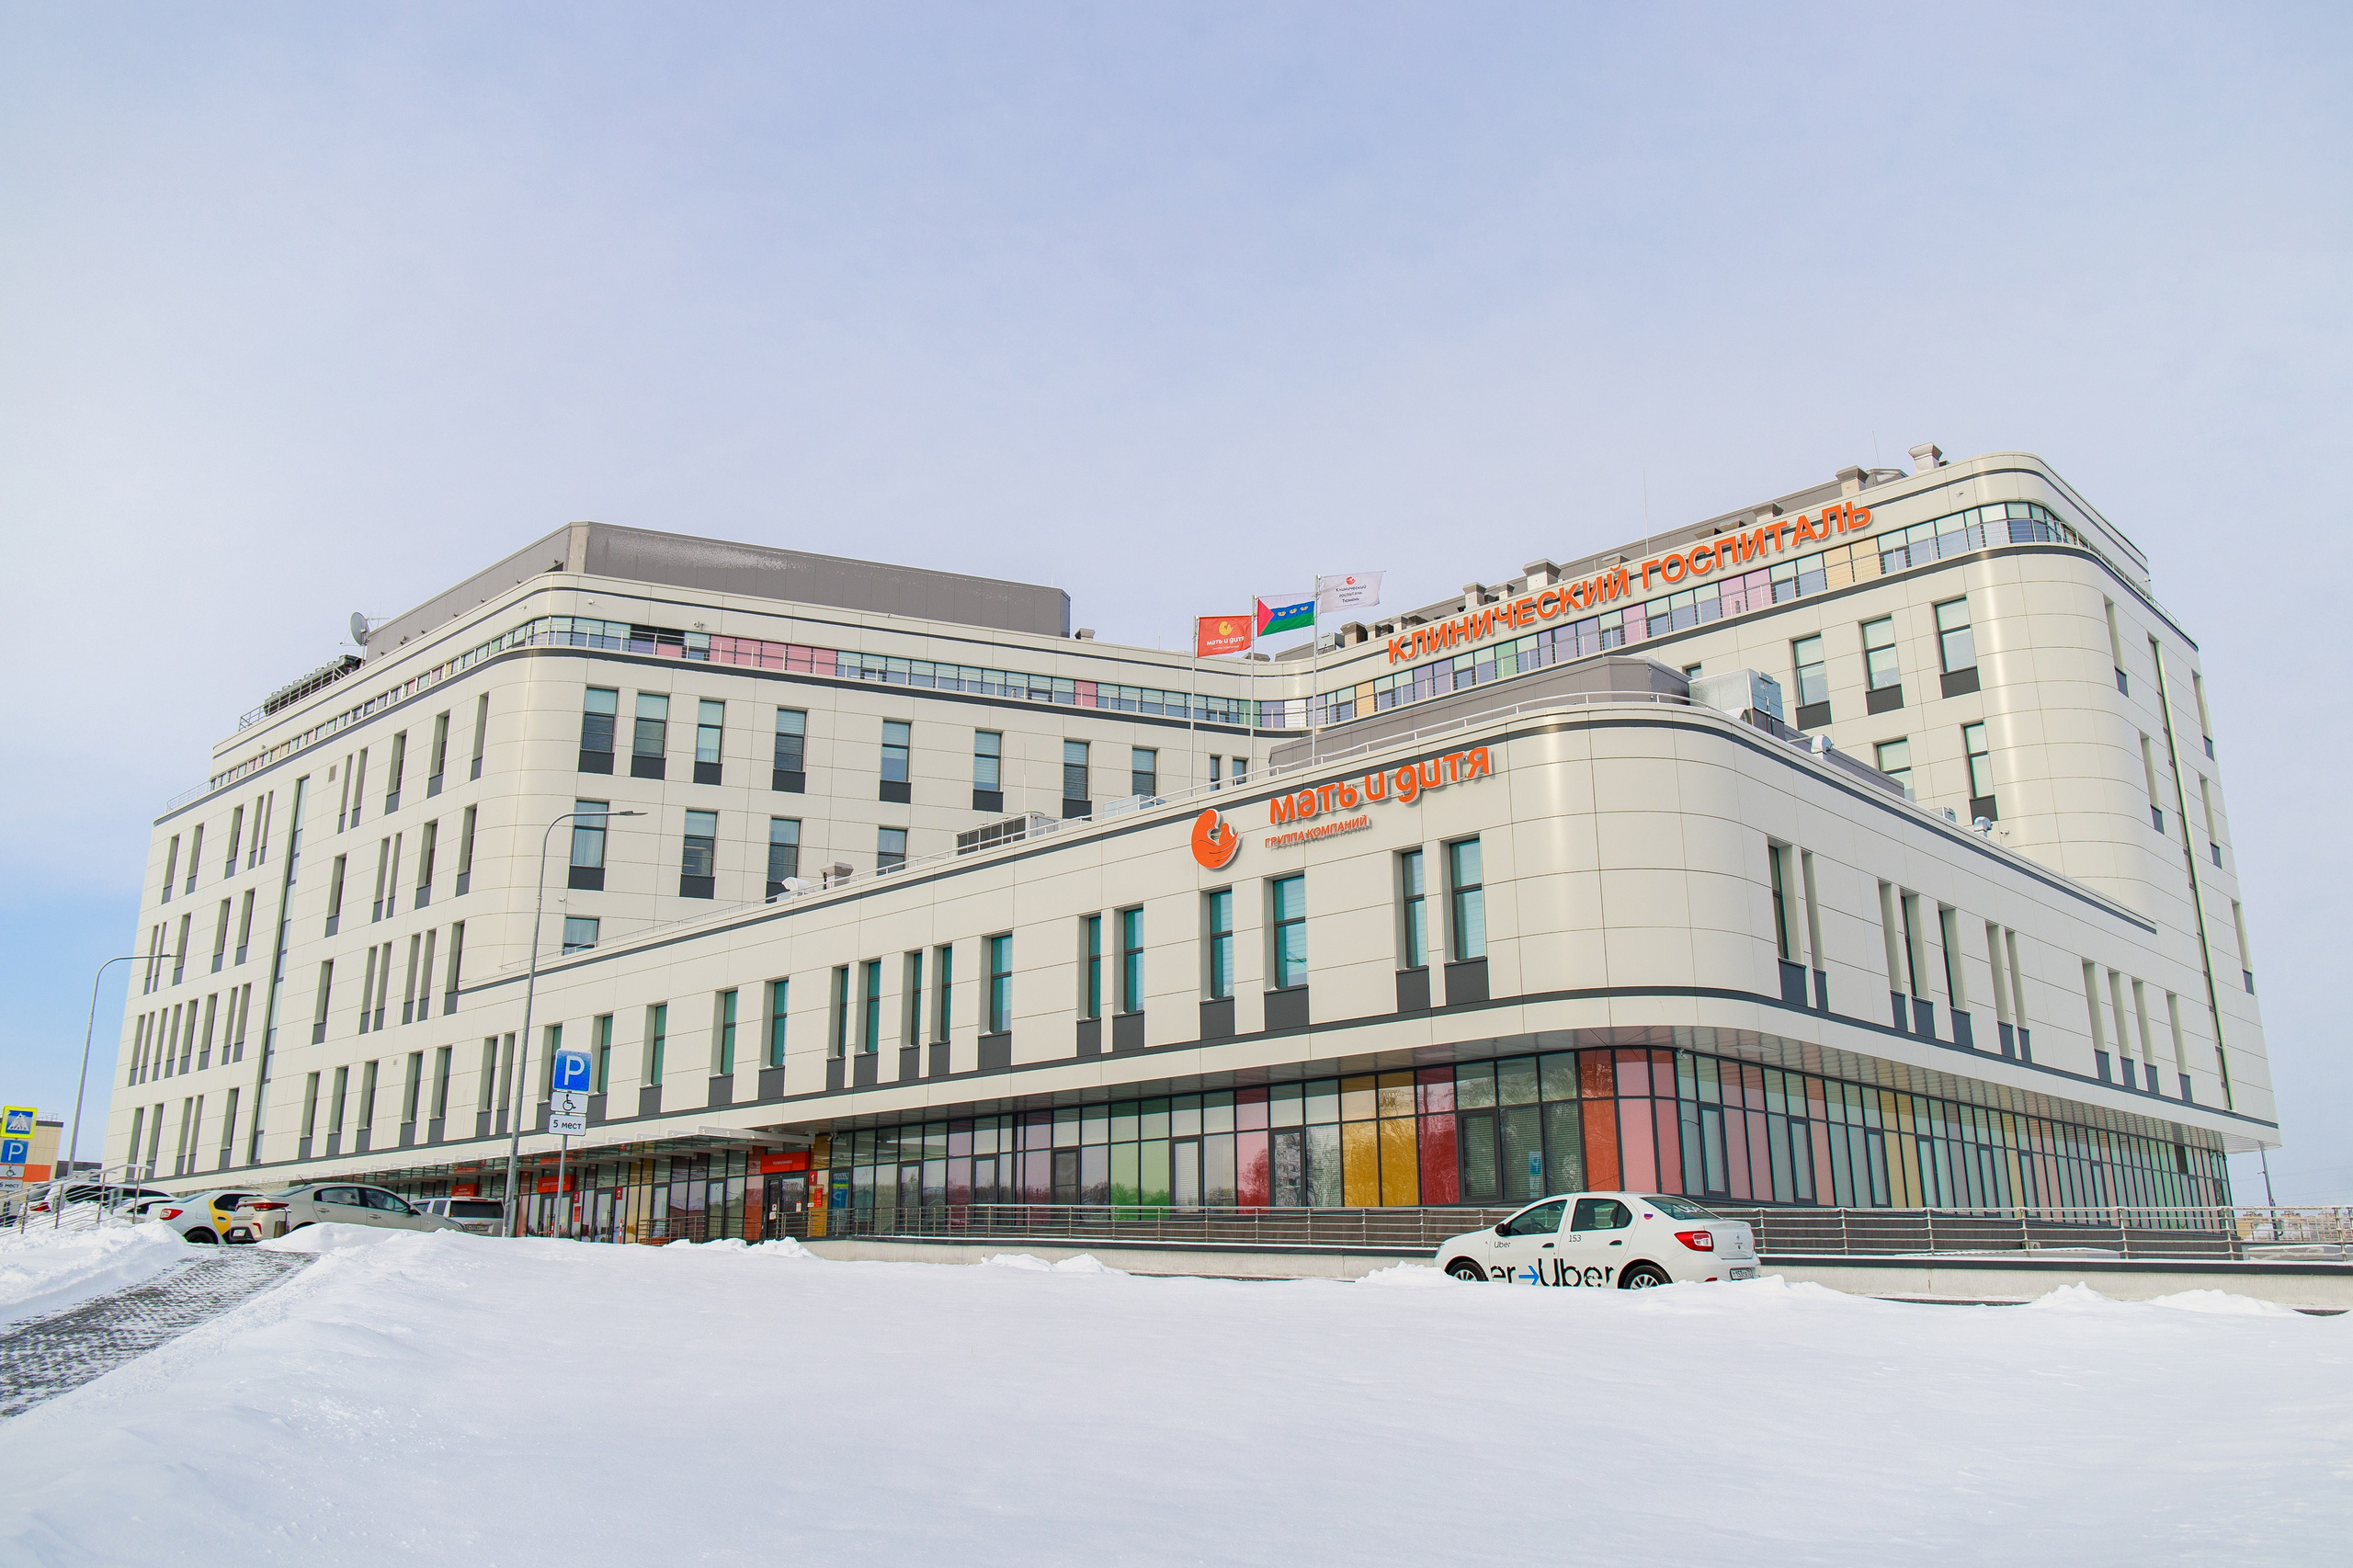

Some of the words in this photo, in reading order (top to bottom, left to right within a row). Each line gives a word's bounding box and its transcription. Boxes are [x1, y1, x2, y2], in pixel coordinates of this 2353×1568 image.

[1388, 563, 1631, 664] КЛИНИЧЕСКИЙ
[1642, 501, 1872, 590] ГОСПИТАЛЬ
[1365, 771, 1388, 801] и
[1265, 830, 1305, 848] ГРУППА
[1306, 814, 1370, 839] КОМПАНИЙ
[563, 1055, 585, 1085] P
[553, 1119, 559, 1128] 5
[8, 1142, 24, 1162] P
[811, 1174, 814, 1182] 1
[1568, 1234, 1582, 1243] 153
[1538, 1257, 1615, 1288] Uber
